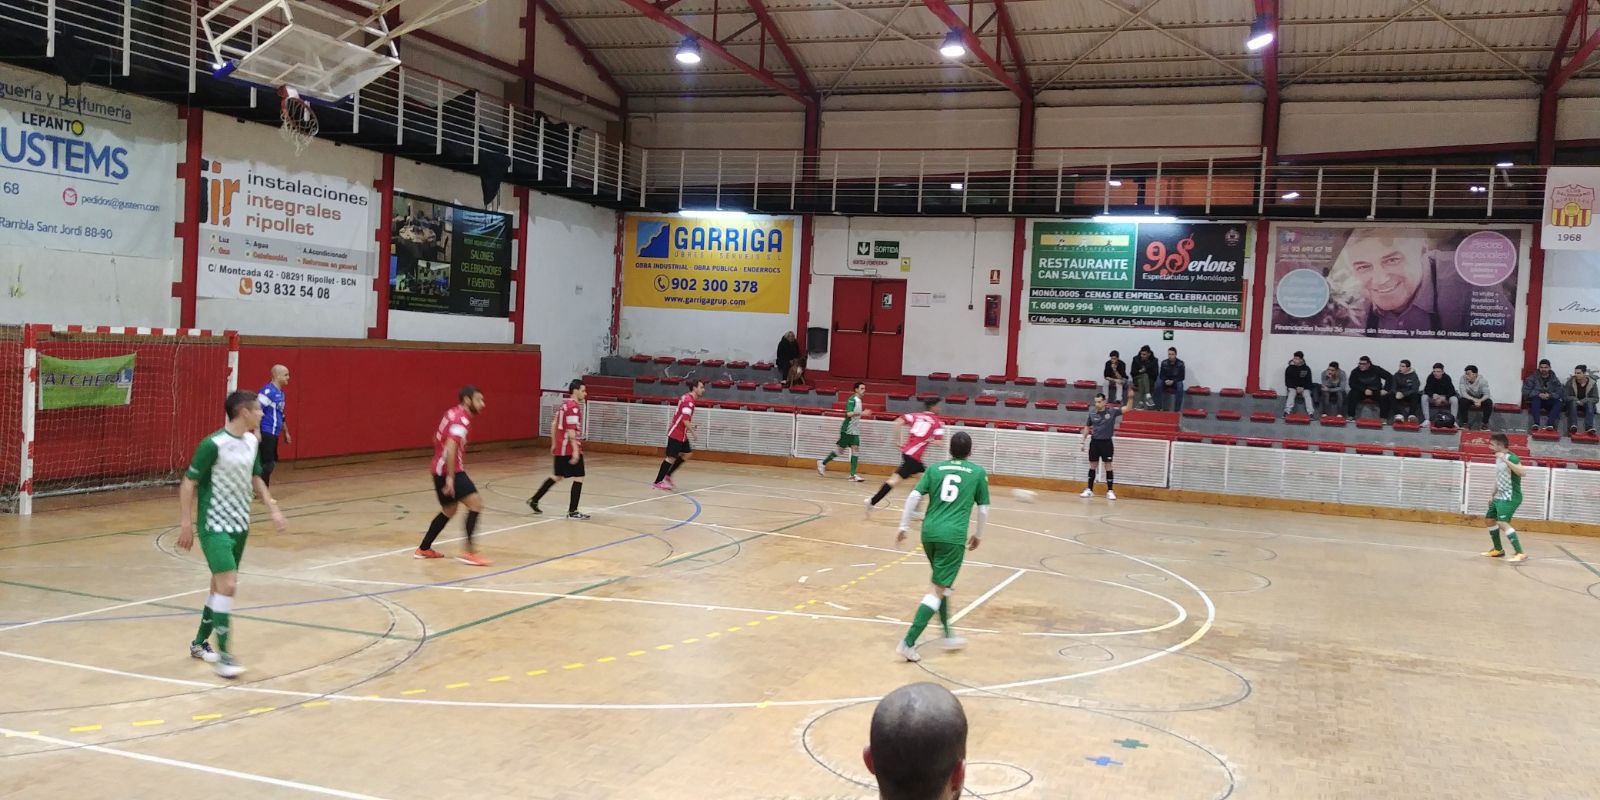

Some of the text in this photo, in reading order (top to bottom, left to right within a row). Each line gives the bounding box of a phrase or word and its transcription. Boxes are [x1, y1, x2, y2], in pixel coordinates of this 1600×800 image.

[47, 91, 54, 108] y
[22, 111, 84, 136] LEPANTO
[0, 126, 129, 180] USTEMS
[3, 182, 20, 195] 68
[248, 170, 368, 207] instalaciones
[247, 191, 342, 221] integrales
[36, 221, 58, 233] Sant
[60, 223, 83, 235] Jordi
[85, 227, 113, 239] 88-90
[246, 213, 315, 236] ripollet
[674, 226, 783, 253] GARRIGA
[1557, 233, 1582, 242] 1968
[874, 245, 899, 254] SORTIDA
[1039, 258, 1129, 270] RESTAURANTE
[208, 264, 357, 286] C/ Montcada 42 08291 Ripollet BCN
[1038, 270, 1129, 281] CAN SALVATELLA
[255, 281, 330, 300] 93 832 54 08
[671, 278, 758, 293] 902 300 378
[664, 296, 746, 306] www.garrigagrup.com
[1032, 288, 1080, 298] MONÓLOGOS
[1084, 291, 1112, 299] CENAS
[1125, 292, 1165, 300] EMPRESA
[1168, 292, 1238, 302] CELEBRACIONES
[1040, 302, 1057, 310] 608
[1058, 302, 1075, 310] 009
[1076, 303, 1094, 311] 994
[1103, 304, 1238, 316] www.gruposalvatella.com
[1131, 319, 1166, 327] Salvatella
[1470, 318, 1505, 326] ¡GRATIS!
[1482, 331, 1510, 339] entrada
[940, 473, 962, 503] 6
